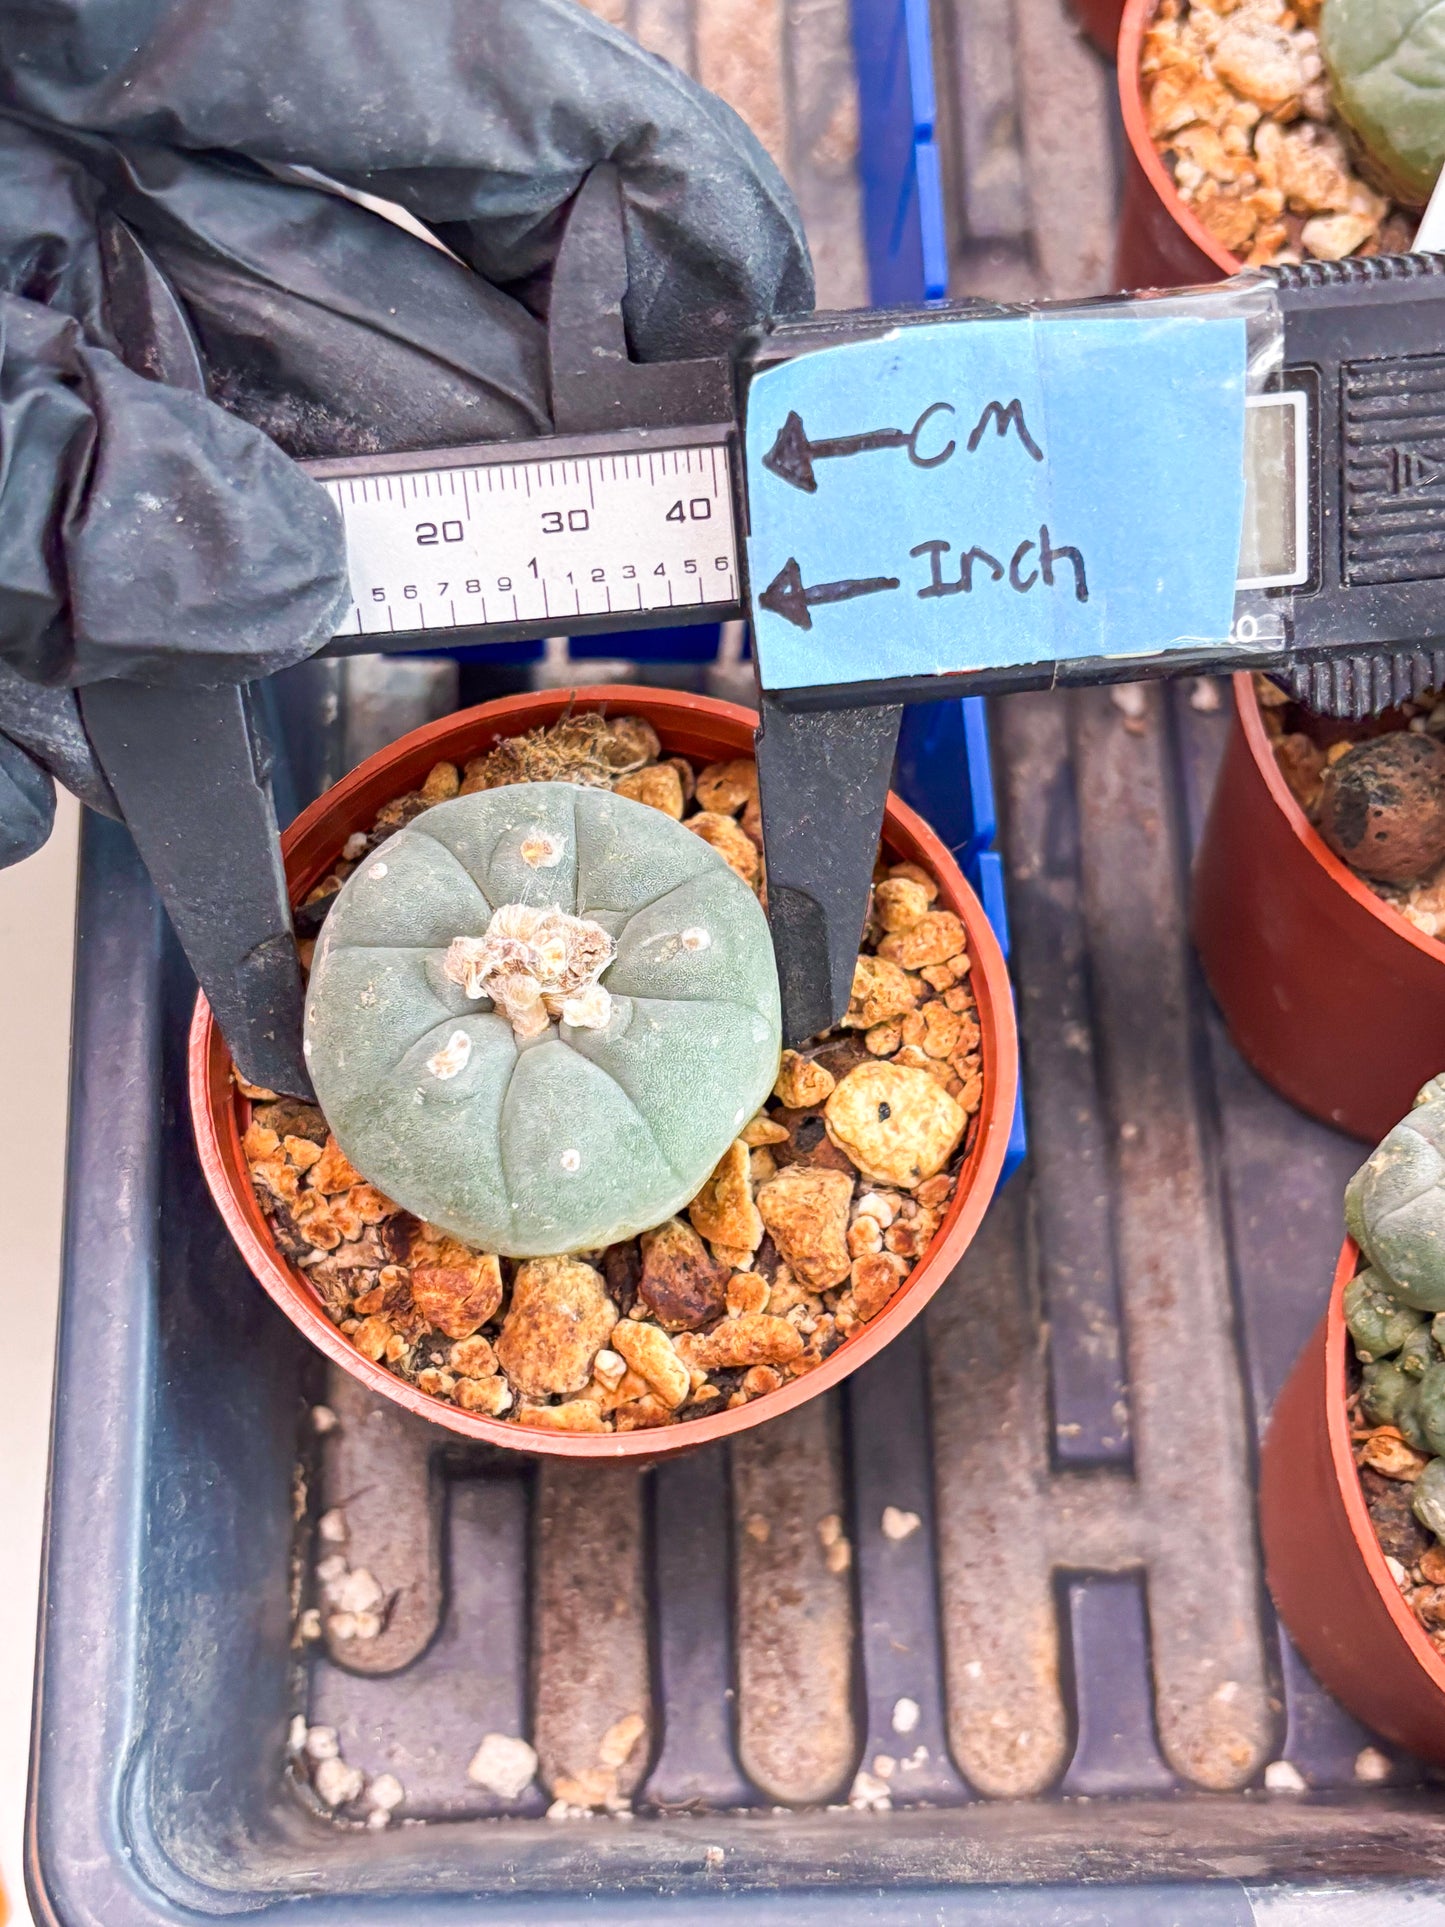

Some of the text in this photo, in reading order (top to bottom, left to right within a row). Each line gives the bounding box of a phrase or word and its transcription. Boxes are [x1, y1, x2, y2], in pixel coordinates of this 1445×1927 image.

[414, 497, 712, 546] 20 30 40
[371, 556, 729, 602] 5 6 7 8 9 1 1 2 3 4 5 6
[909, 523, 1090, 603] Inch
